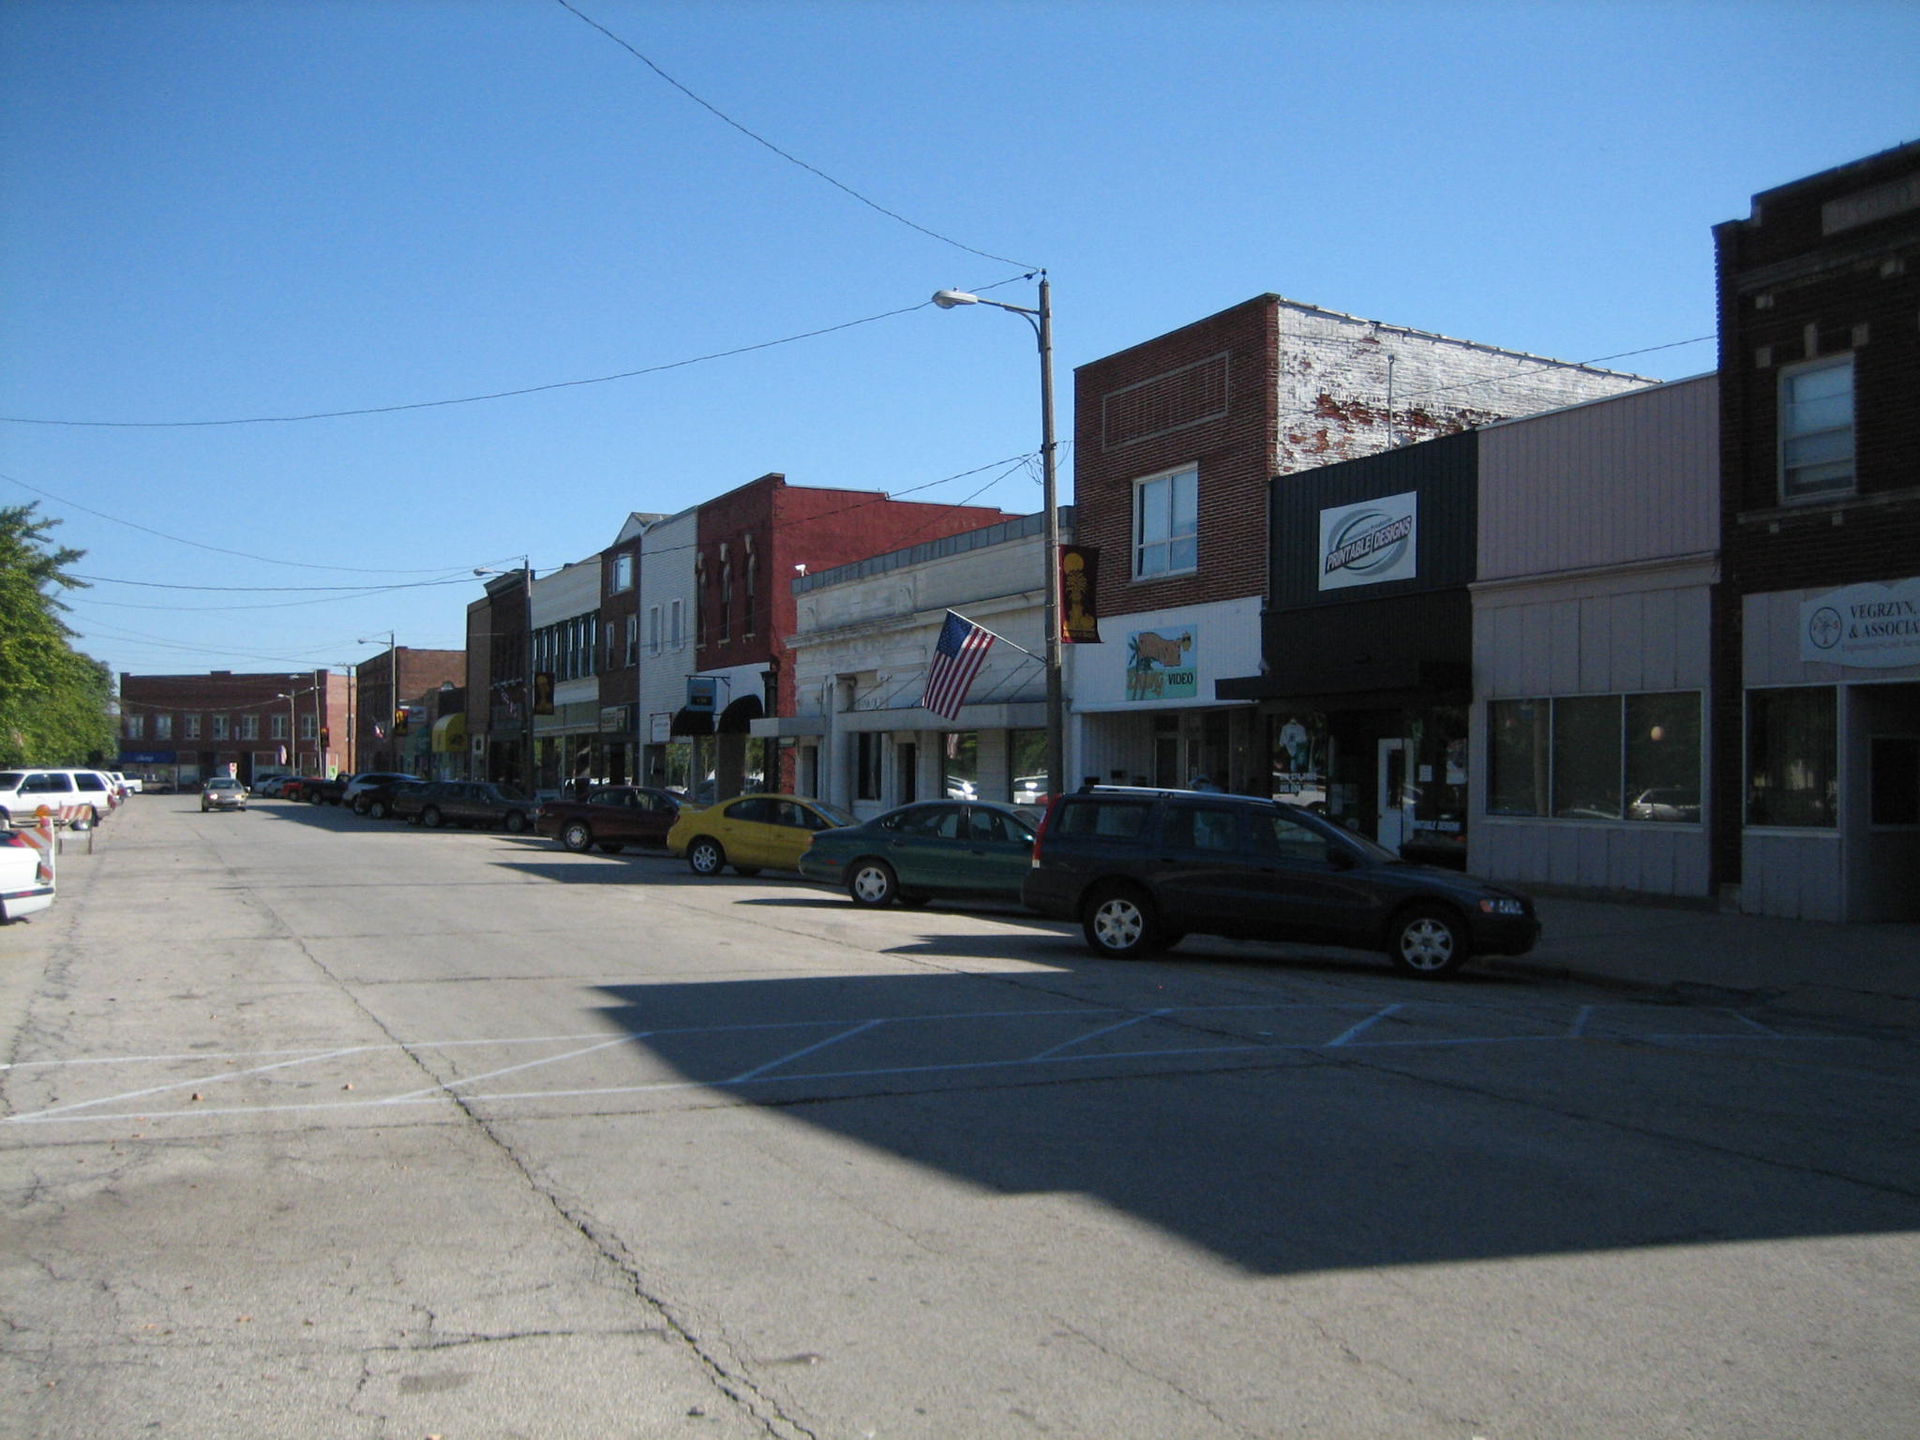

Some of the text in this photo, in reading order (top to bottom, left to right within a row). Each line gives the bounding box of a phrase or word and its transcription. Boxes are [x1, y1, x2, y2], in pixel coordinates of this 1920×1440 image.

[1326, 534, 1371, 572] PRINTABLE
[1373, 517, 1411, 550] DESIGNS
[1849, 620, 1920, 639] & ASSOCIA
[1168, 671, 1194, 686] VIDEO
